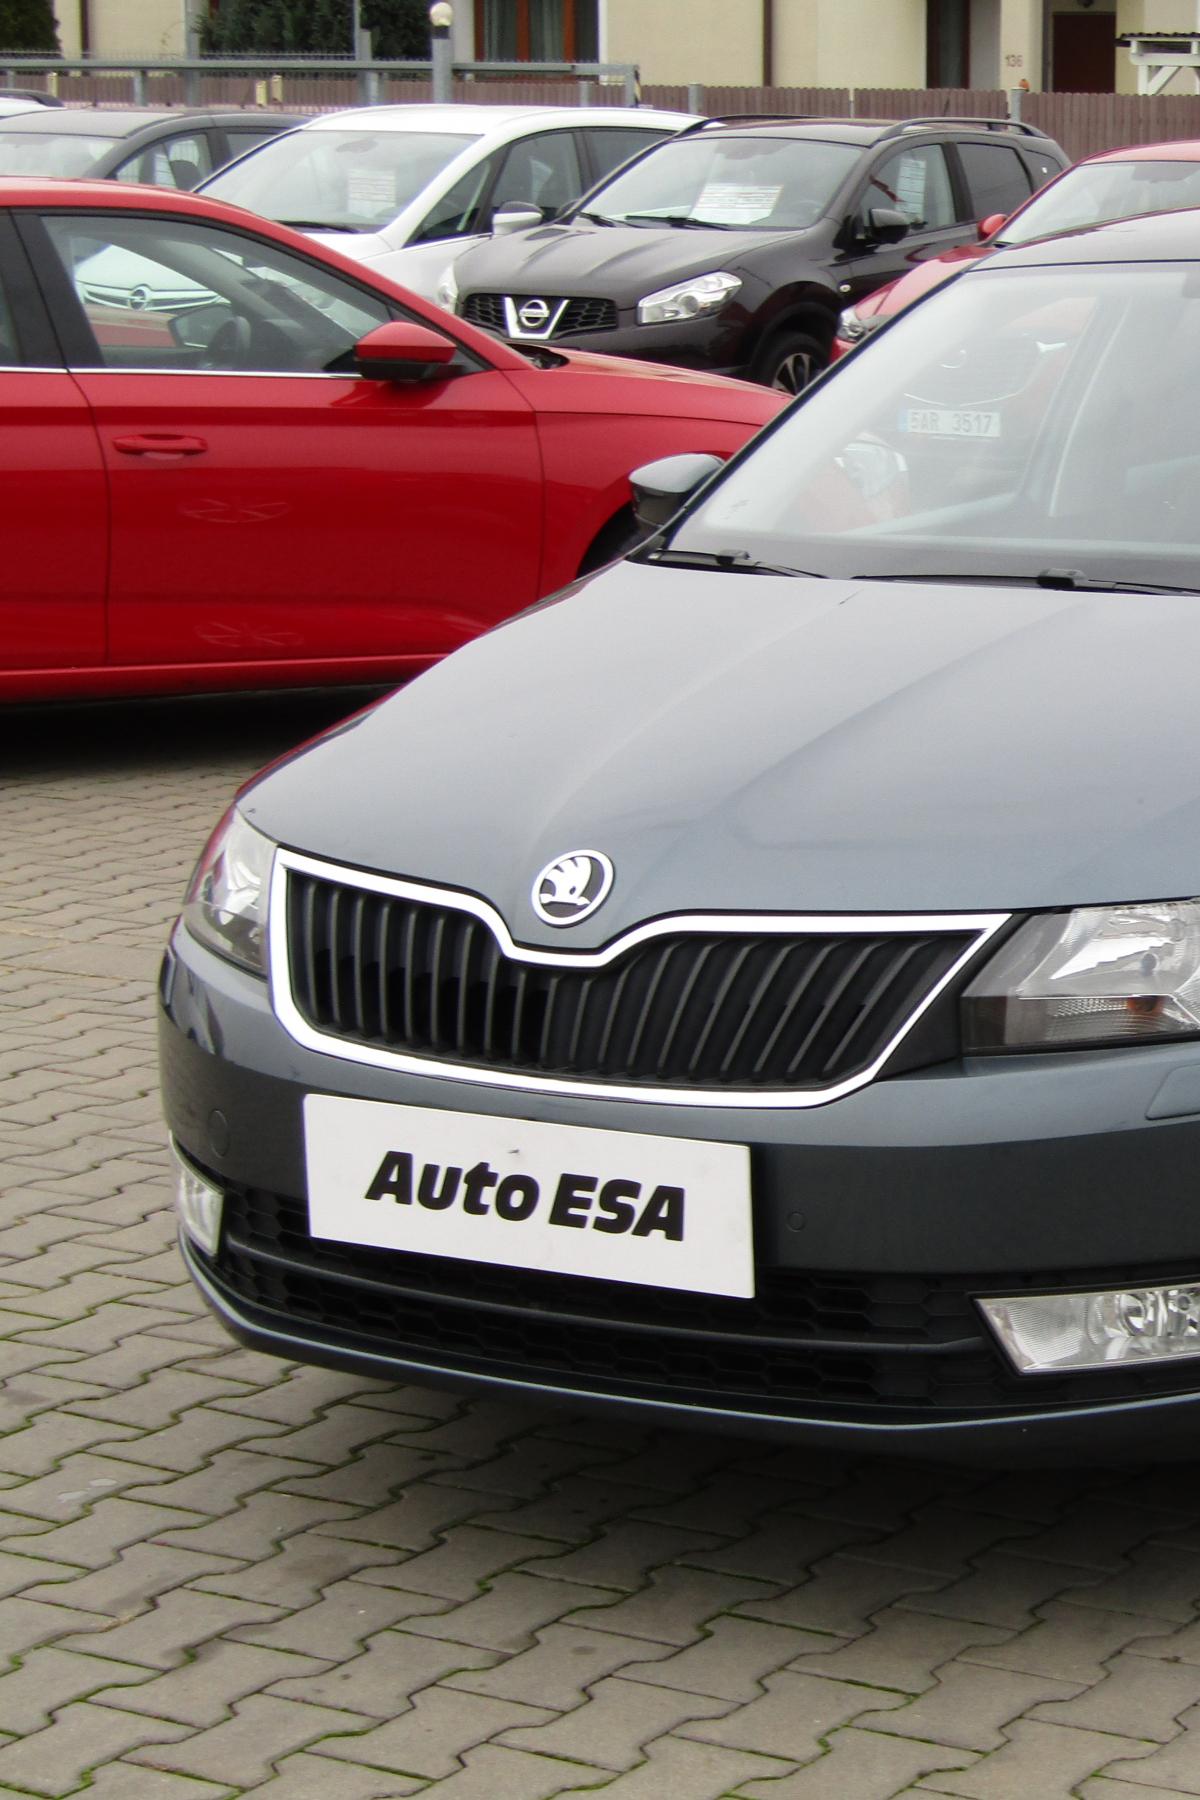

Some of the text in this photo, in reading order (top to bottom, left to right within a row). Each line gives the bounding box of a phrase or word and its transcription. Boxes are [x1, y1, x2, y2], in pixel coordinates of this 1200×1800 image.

[951, 412, 993, 434] 3517
[365, 1150, 686, 1242] Auto ESA
